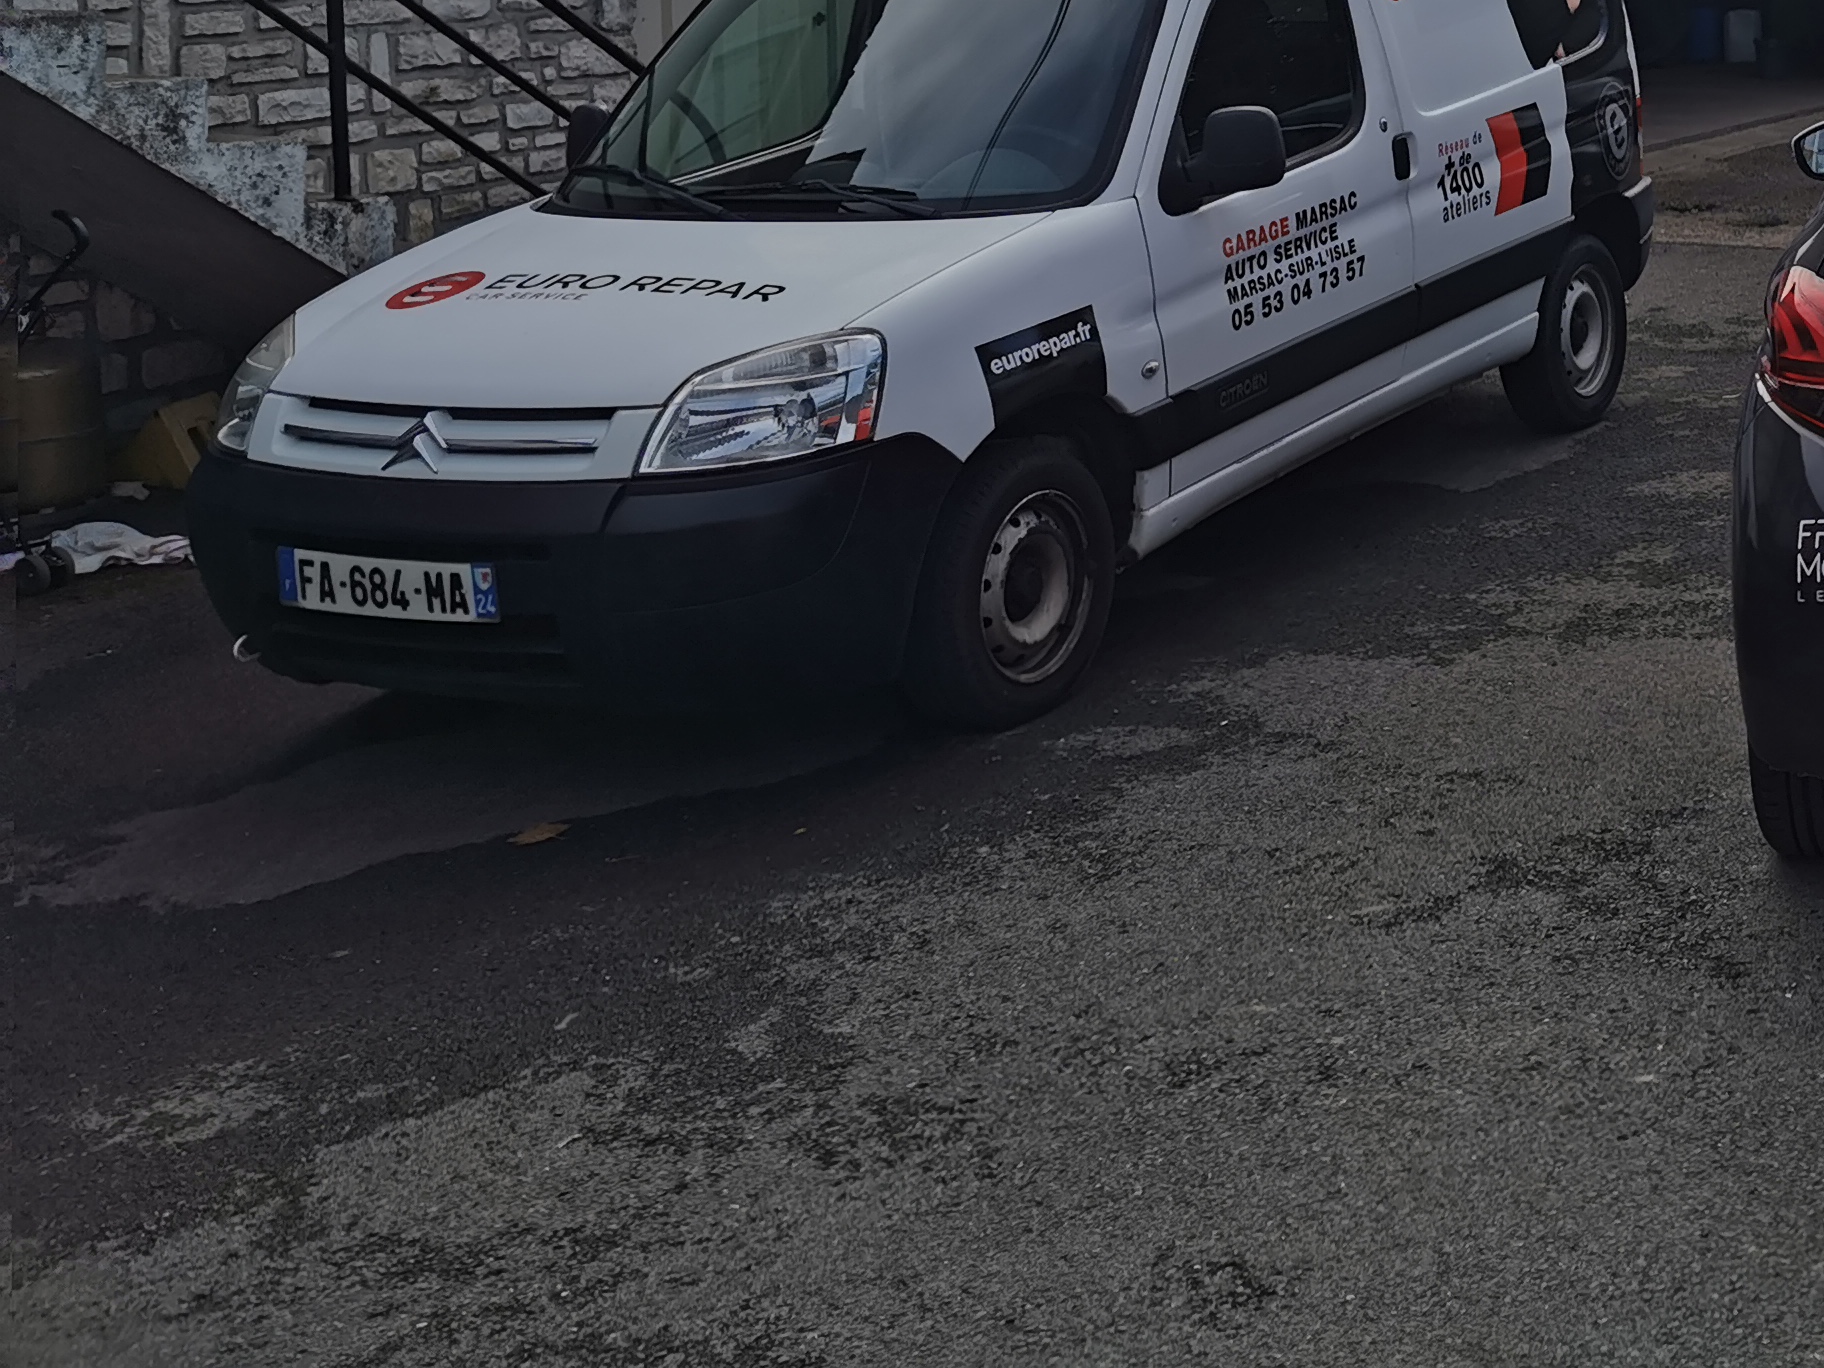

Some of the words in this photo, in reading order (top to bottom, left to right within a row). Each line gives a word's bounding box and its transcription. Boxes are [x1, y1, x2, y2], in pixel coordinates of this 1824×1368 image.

[1438, 137, 1470, 158] Réseau
[1472, 130, 1483, 145] de
[1458, 150, 1472, 168] de
[1437, 161, 1485, 202] 1400
[1222, 216, 1291, 259] GARAGE
[1294, 190, 1358, 232] MARSAC
[1442, 190, 1492, 223] ateliers
[1224, 249, 1268, 285] AUTO
[1273, 221, 1339, 264] SERVICE
[1226, 238, 1357, 306] MARSAC-SUR-L'ISLE
[465, 292, 508, 301] CAR
[508, 292, 590, 301] SERVICE
[484, 273, 621, 291] EURO
[620, 276, 787, 303] REPAR
[1231, 302, 1255, 331] 05
[1261, 290, 1284, 319] 53
[1290, 278, 1313, 306] 04
[1318, 266, 1340, 294] 73
[1345, 254, 1366, 282] 57
[989, 321, 1092, 375] eurorepar.fr
[298, 558, 471, 616] FA-684-MA
[476, 594, 497, 615] 24
